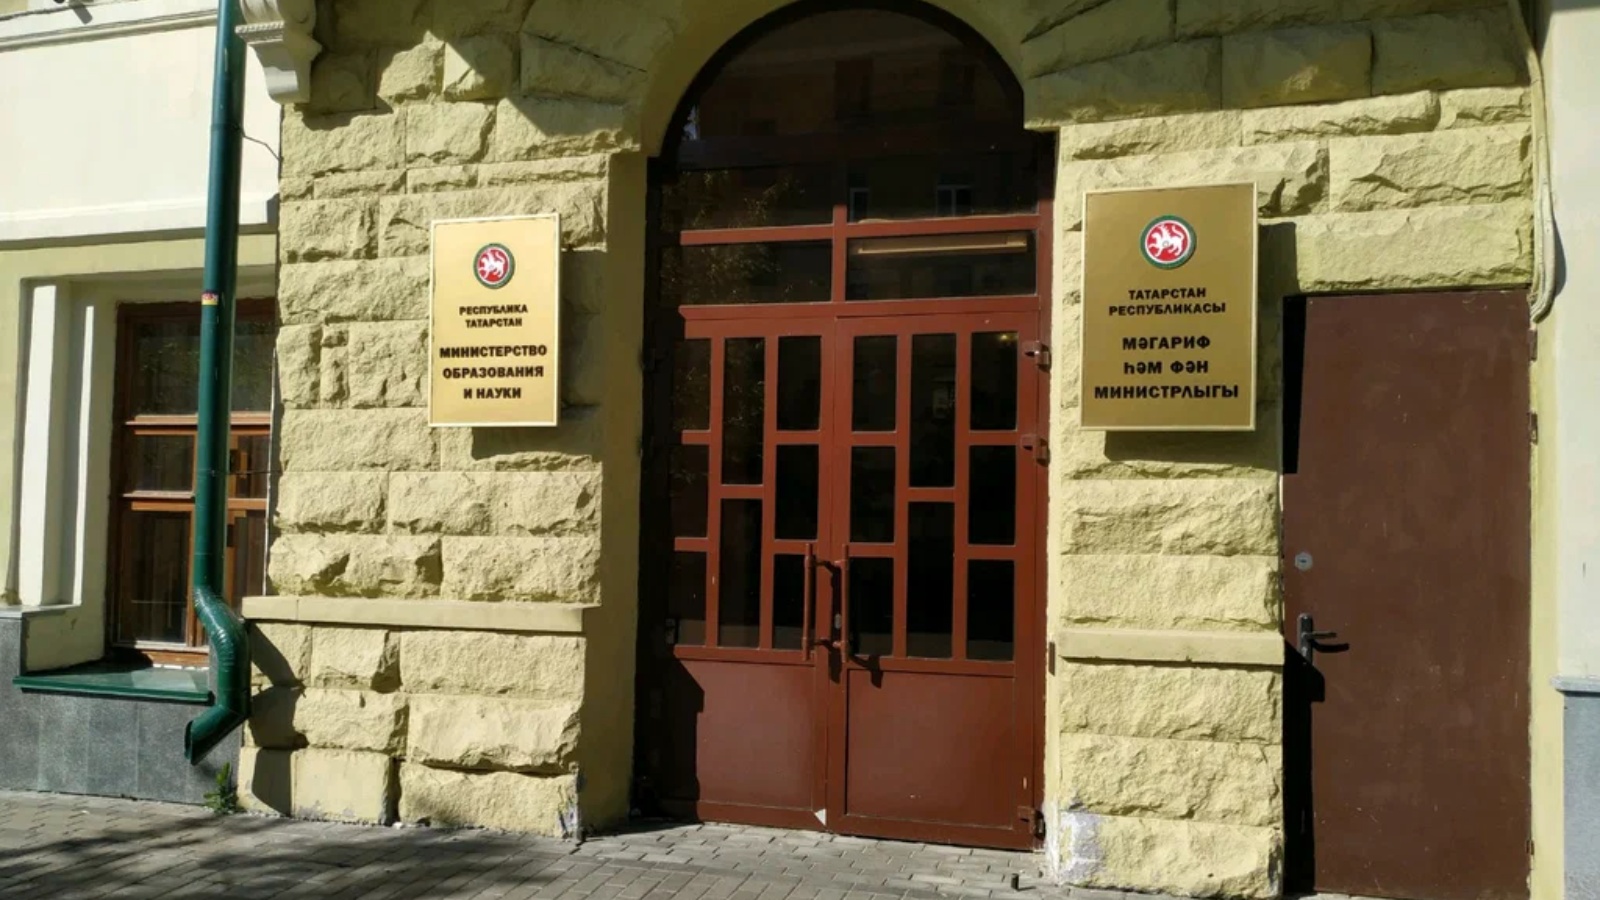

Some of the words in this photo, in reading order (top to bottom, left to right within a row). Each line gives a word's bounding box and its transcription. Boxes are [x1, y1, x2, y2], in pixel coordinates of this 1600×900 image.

[1128, 287, 1206, 300] ТАТАРСТАН
[459, 304, 528, 316] РЕСПУБЛИКА
[1109, 302, 1226, 316] РЕСПУБЛИКАСЫ
[465, 318, 522, 328] ТАТАРСТАН
[440, 344, 547, 358] МИНИСТЕРСТВО
[443, 365, 544, 379] ОБРАЗОВАНИЯ
[463, 388, 473, 399] И
[476, 387, 521, 399] НАУКИ
[1094, 384, 1239, 399] МИНИСТРЛЫГЫ
